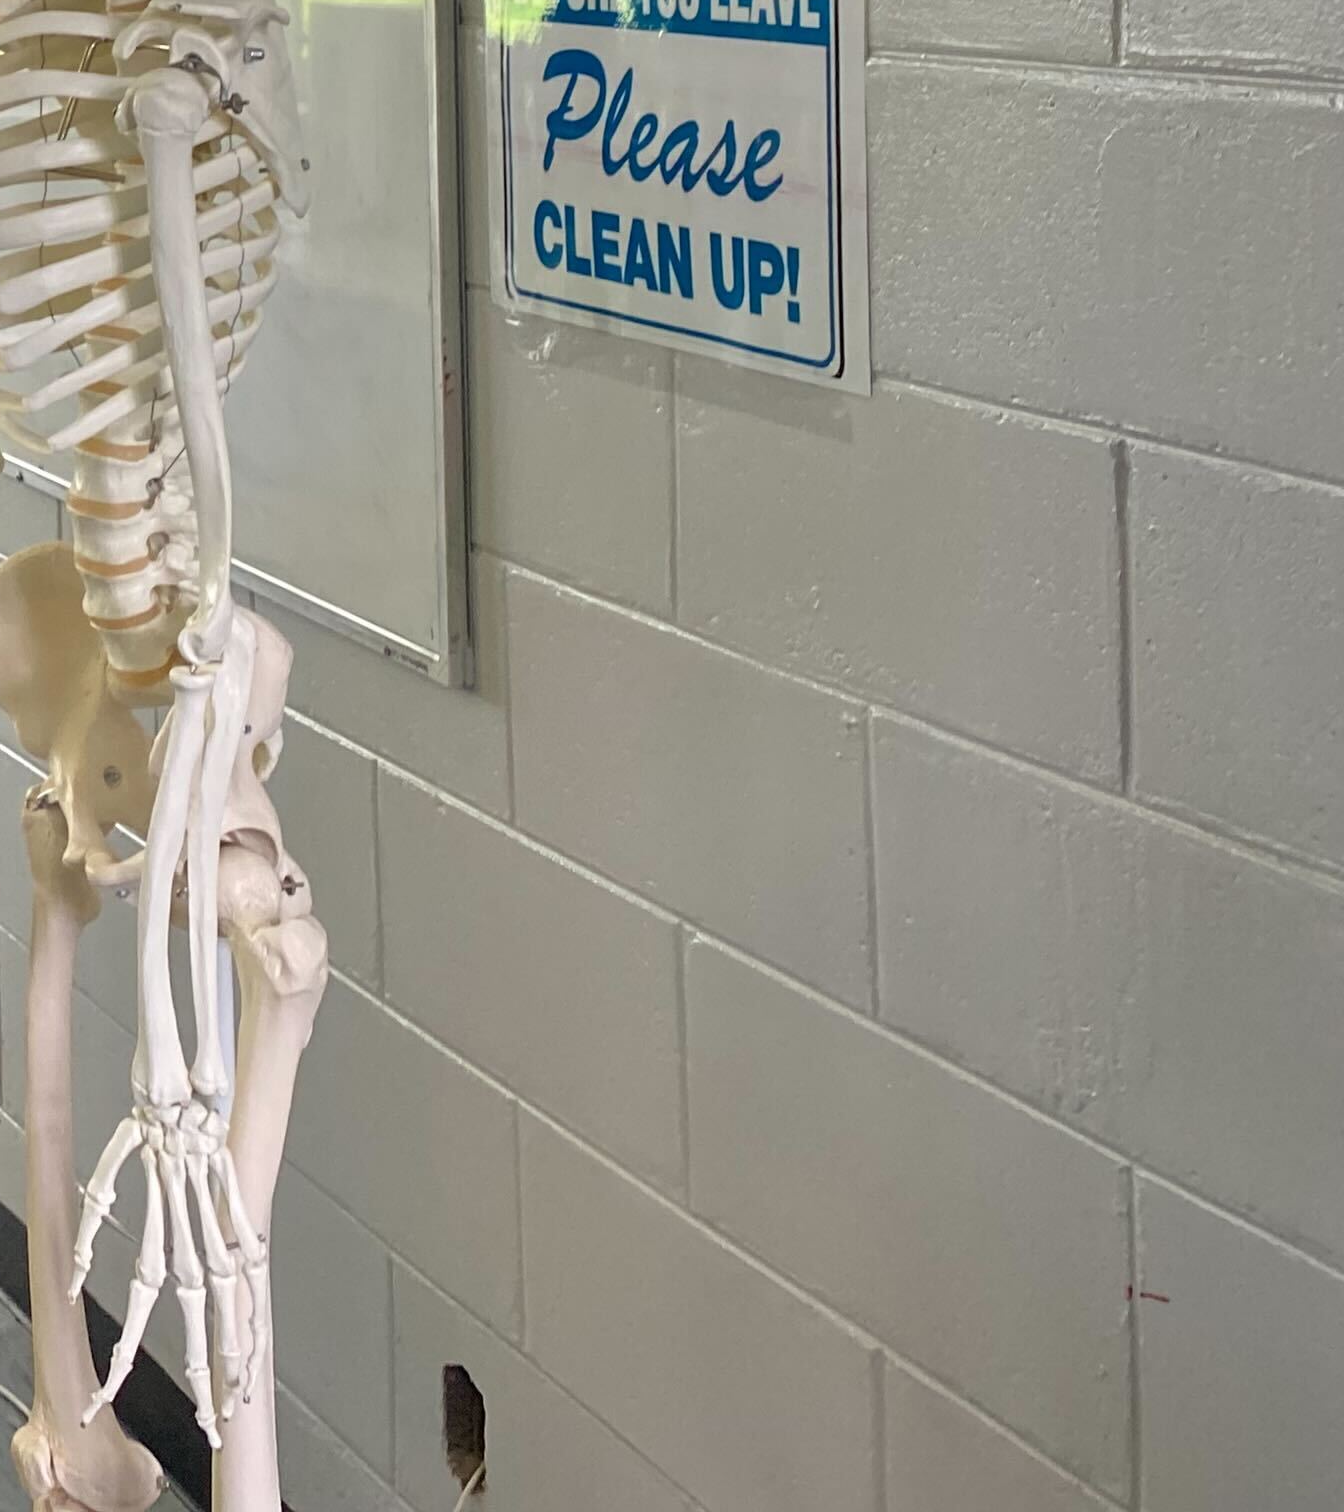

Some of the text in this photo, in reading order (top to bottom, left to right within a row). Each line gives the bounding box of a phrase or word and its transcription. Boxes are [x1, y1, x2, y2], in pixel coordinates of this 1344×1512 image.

[542, 48, 784, 202] Please
[533, 199, 801, 324] CLEAN UP!
